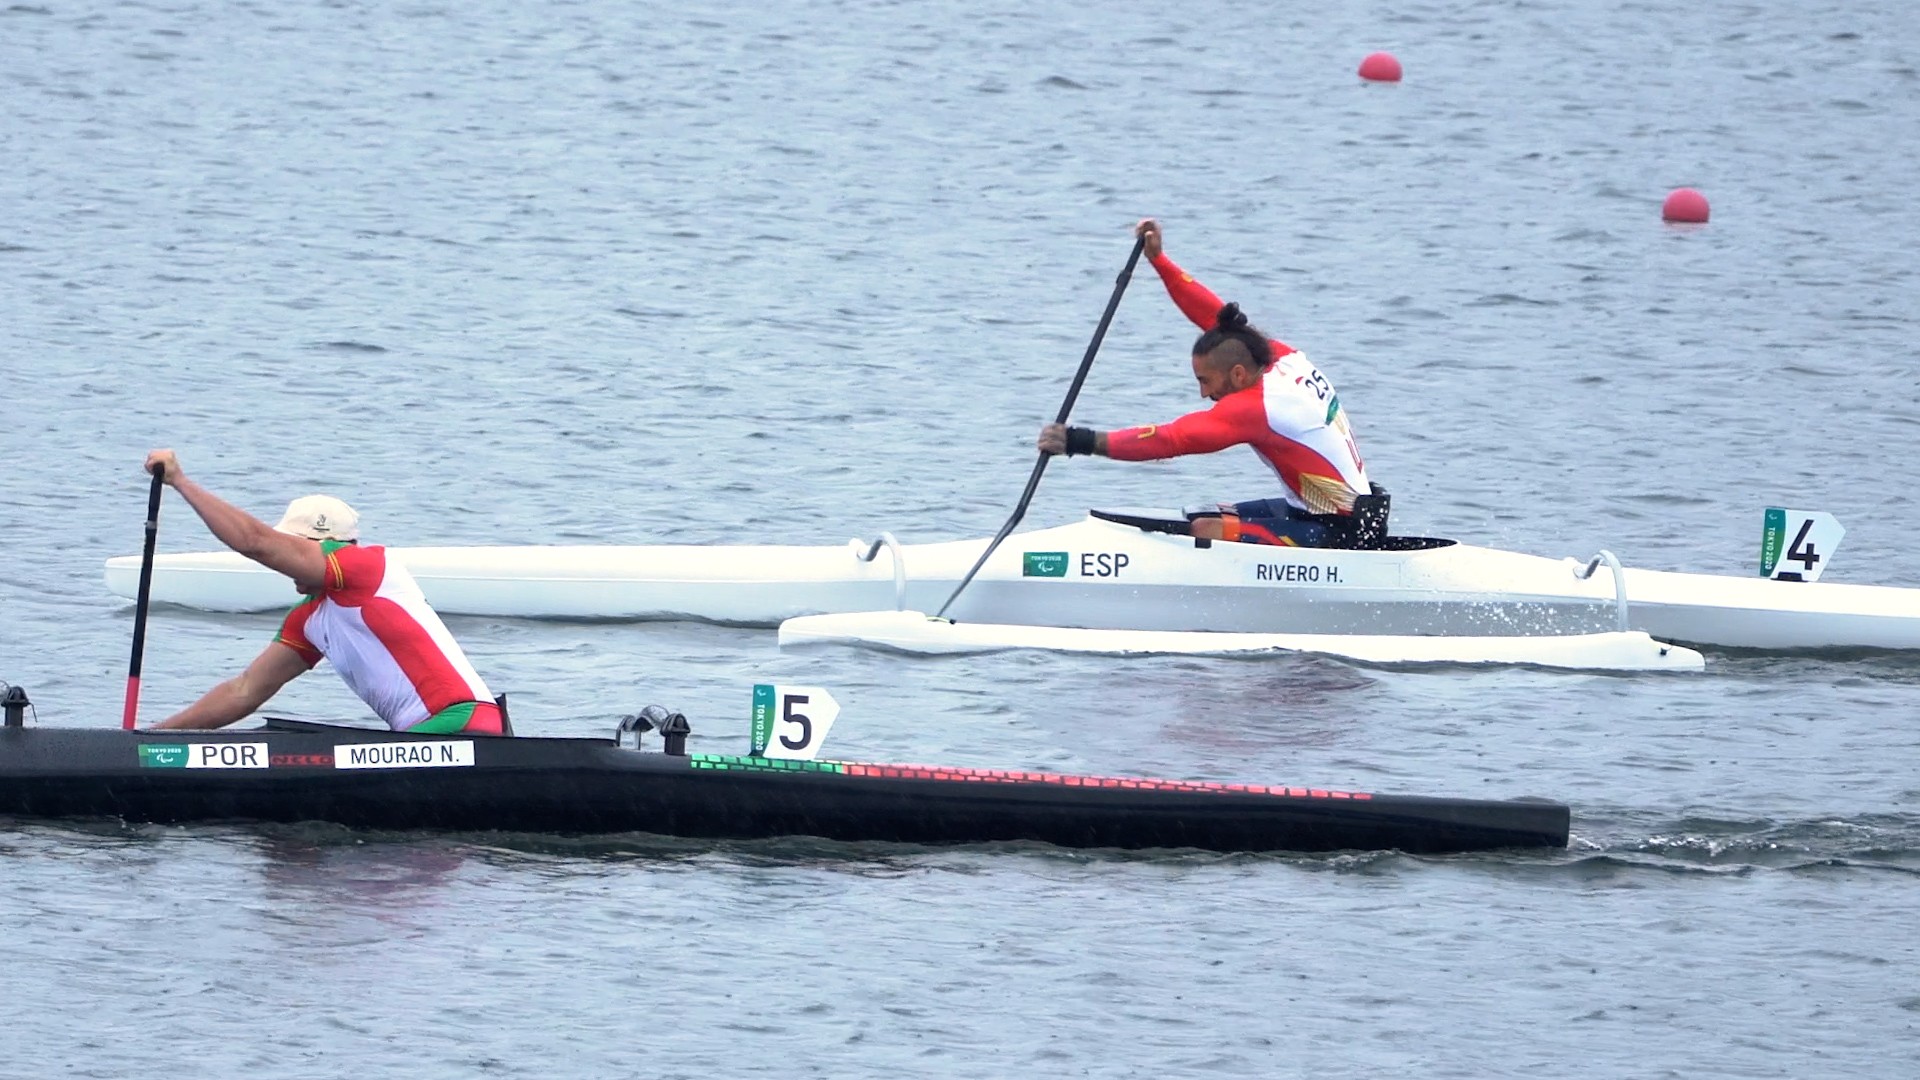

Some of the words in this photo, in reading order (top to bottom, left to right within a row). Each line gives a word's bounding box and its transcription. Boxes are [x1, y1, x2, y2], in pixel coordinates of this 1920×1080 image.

[1305, 369, 1330, 400] 25
[1766, 527, 1776, 551] TOKYO
[1786, 518, 1820, 571] 4
[1080, 552, 1130, 578] ESP
[1764, 552, 1774, 570] 2020
[1256, 563, 1320, 583] RIVERO
[1326, 565, 1344, 584] H.
[756, 703, 766, 731] TOKYO
[779, 693, 813, 751] 5
[755, 731, 764, 751] 2020
[201, 744, 259, 767] POR
[349, 745, 433, 765] MOURAO
[440, 743, 460, 763] N.
